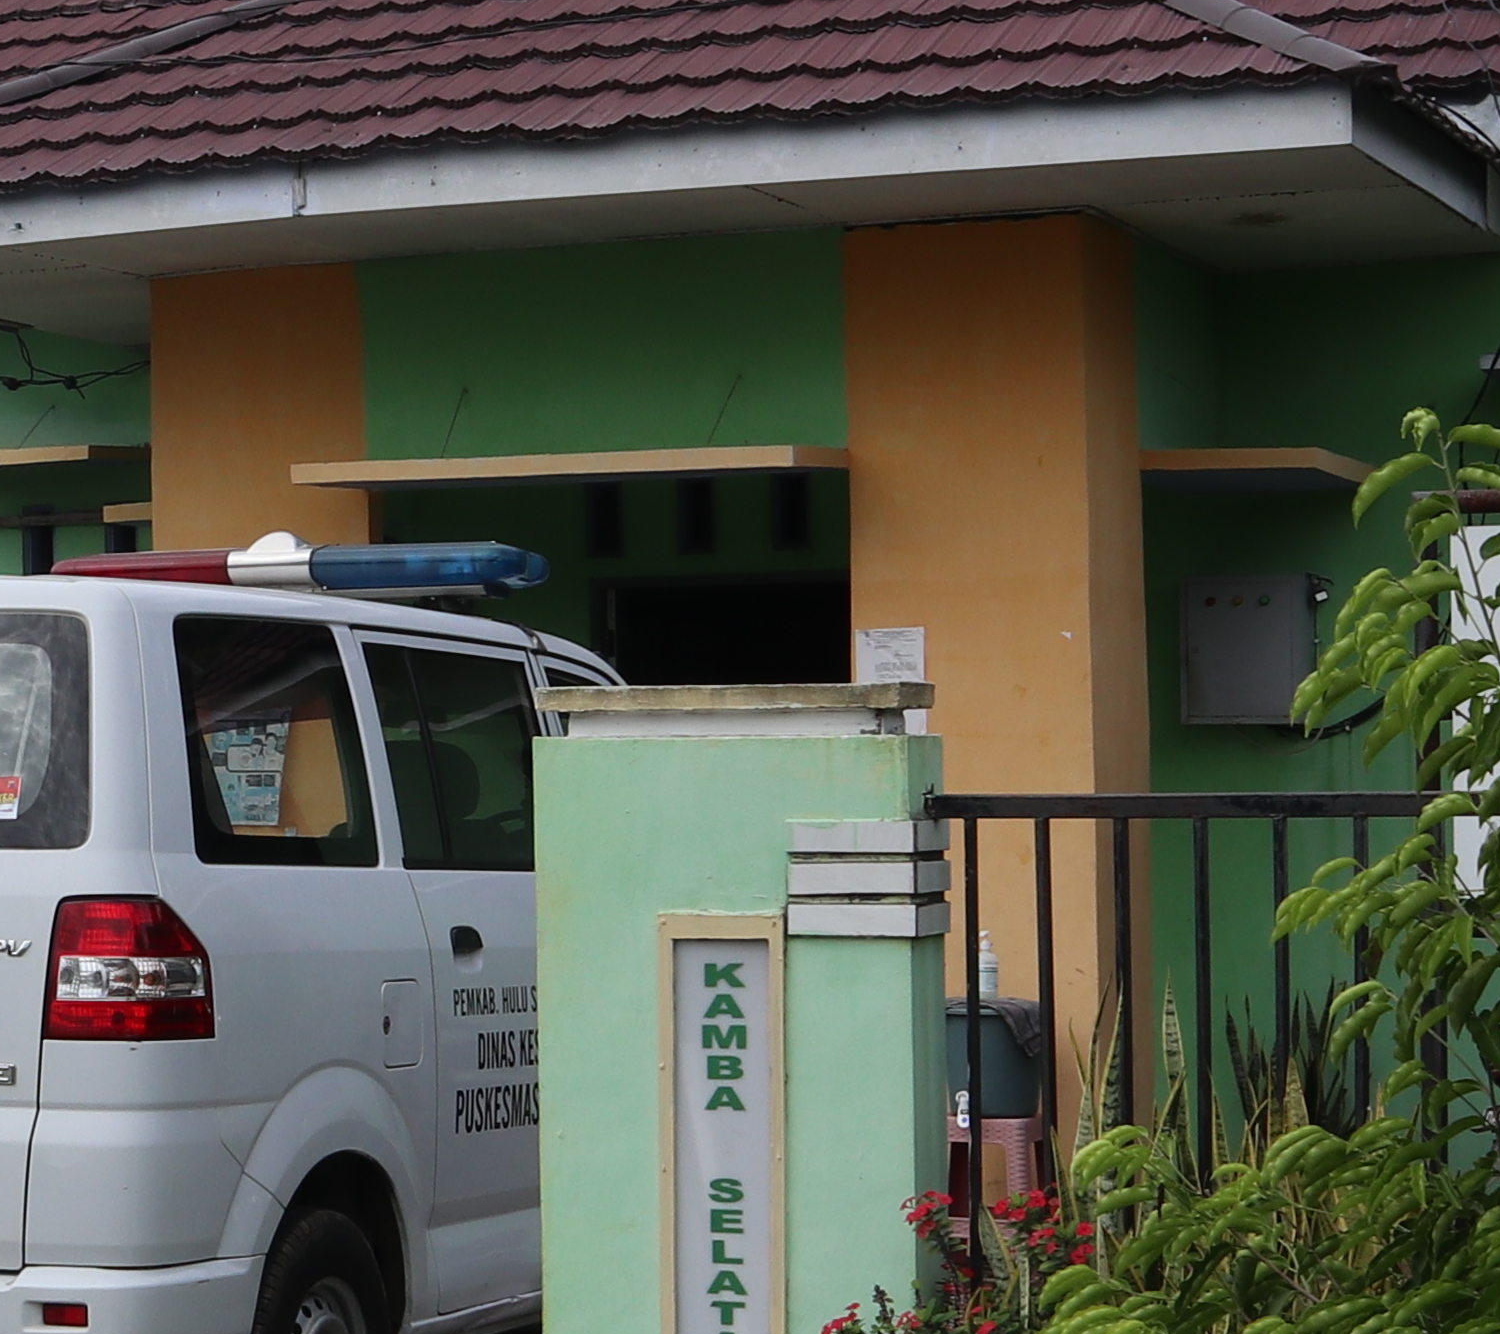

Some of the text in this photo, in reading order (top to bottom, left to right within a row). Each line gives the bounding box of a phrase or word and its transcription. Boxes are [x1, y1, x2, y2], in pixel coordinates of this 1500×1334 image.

[453, 986, 499, 1017] PEMKAB.
[502, 985, 528, 1014] HULU
[477, 1030, 516, 1071] DINAS
[701, 962, 748, 1112] KAMBA
[455, 1081, 540, 1135] PUSKESMAS
